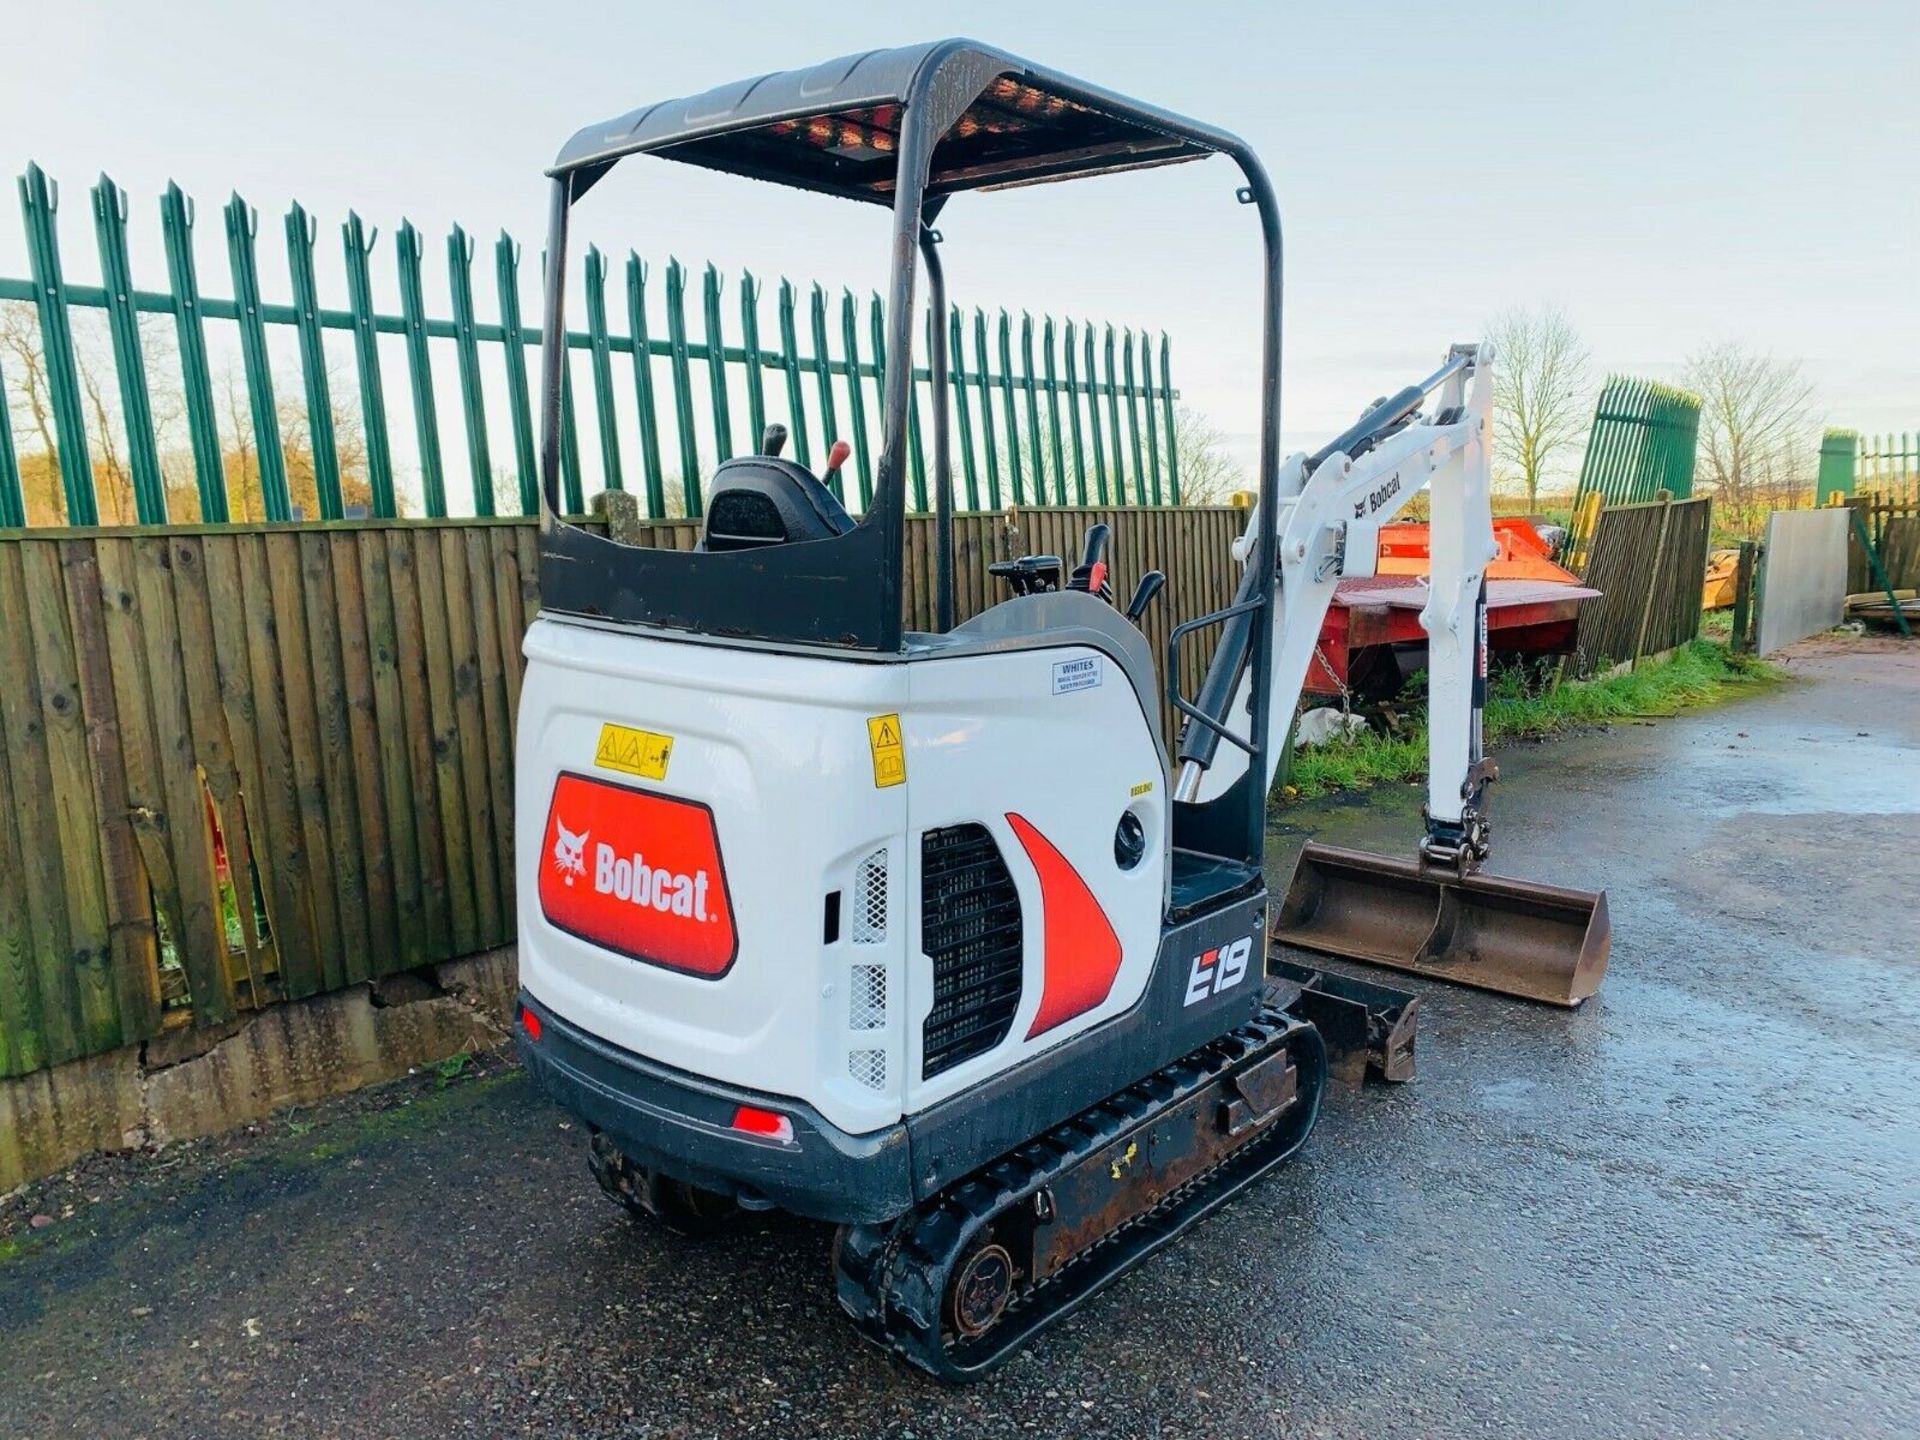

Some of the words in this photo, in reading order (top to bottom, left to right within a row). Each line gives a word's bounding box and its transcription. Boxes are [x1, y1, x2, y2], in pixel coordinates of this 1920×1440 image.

[1370, 471, 1400, 513] Bobcat
[1062, 660, 1094, 674] WHITES
[595, 842, 708, 922] Bobcat
[1183, 935, 1252, 1008] E19
